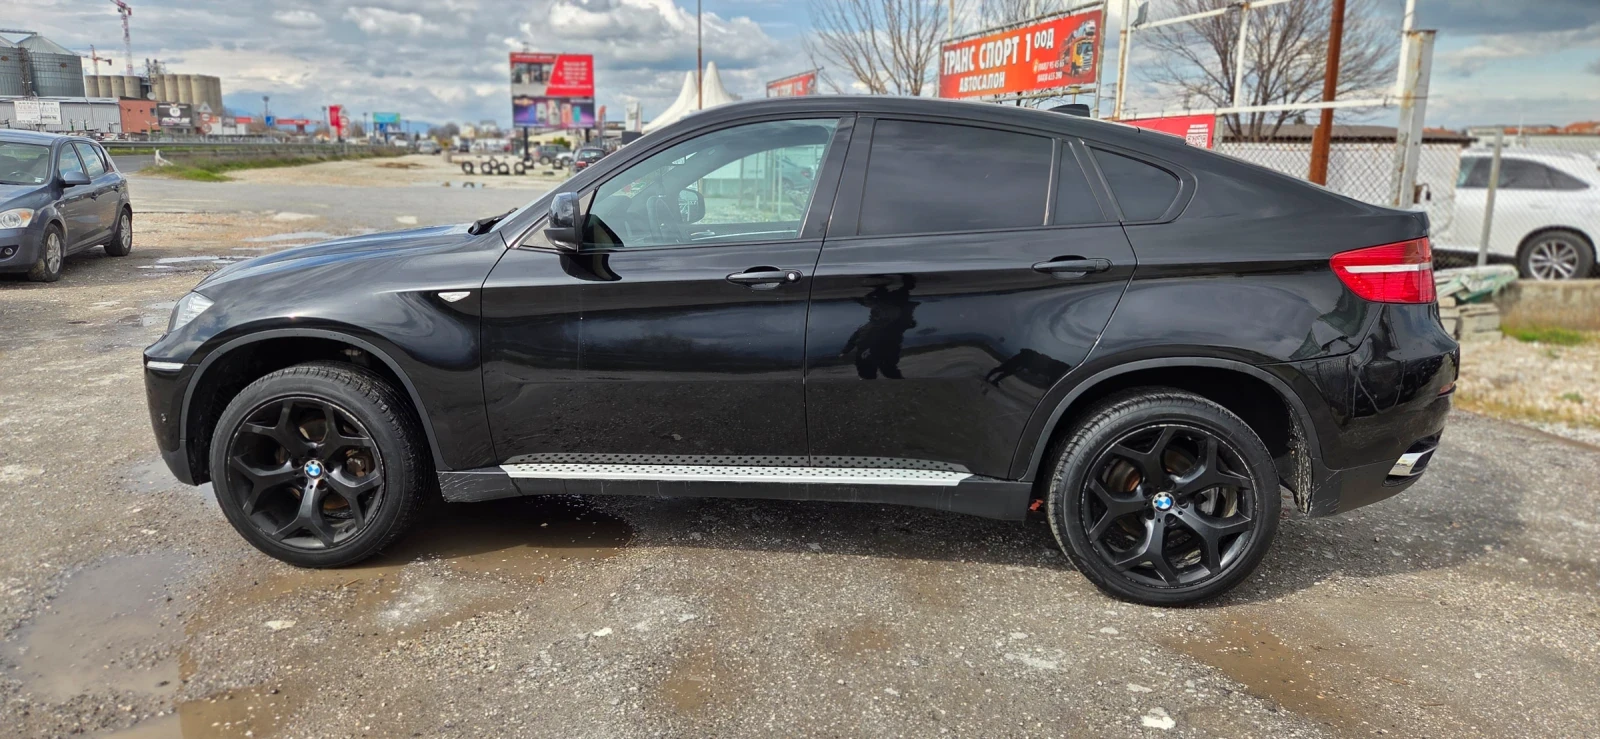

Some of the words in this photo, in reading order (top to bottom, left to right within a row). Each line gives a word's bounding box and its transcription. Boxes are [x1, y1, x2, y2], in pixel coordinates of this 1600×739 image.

[943, 45, 975, 75] ТРАНС
[979, 36, 1020, 70] СПОРТ
[1025, 33, 1032, 62] 1
[1034, 27, 1055, 49] ООД
[958, 71, 1006, 93] АВТОСАЛОН
